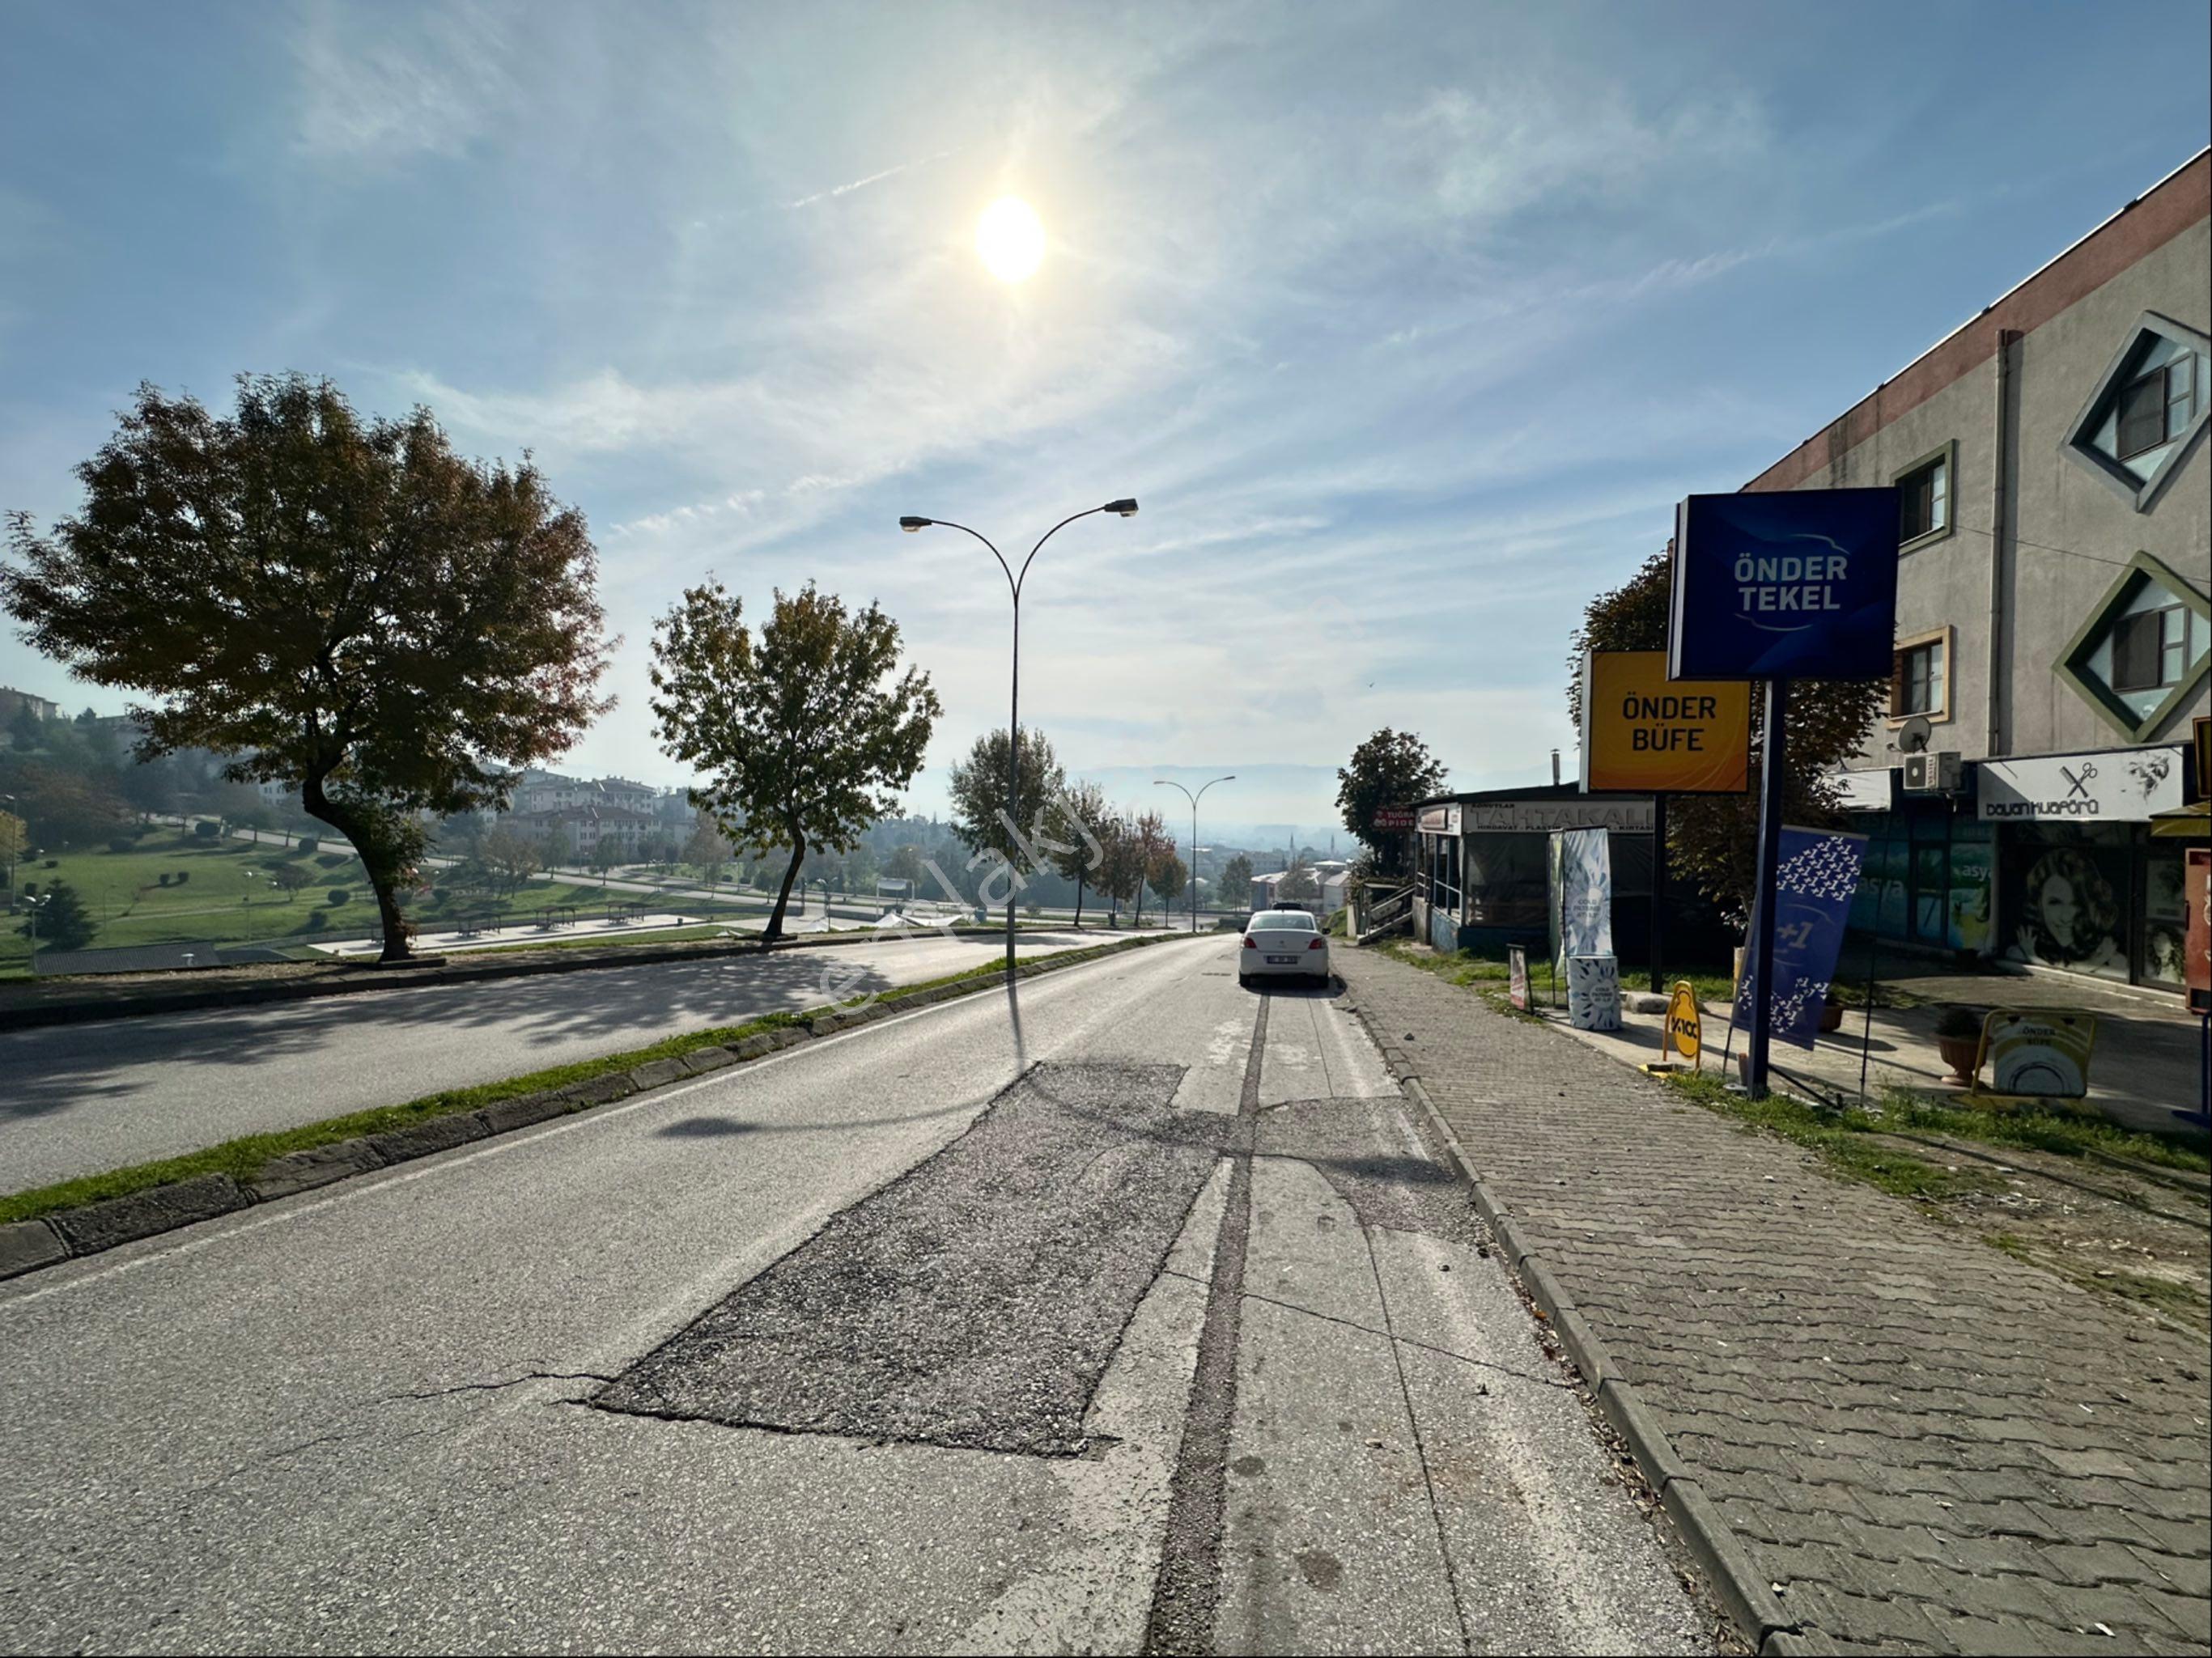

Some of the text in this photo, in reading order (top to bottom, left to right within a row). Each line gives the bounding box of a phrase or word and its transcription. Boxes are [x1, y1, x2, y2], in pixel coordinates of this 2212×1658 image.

[1734, 553, 1848, 582] ÖNDER
[1738, 586, 1841, 611] TEKEL
[1623, 691, 1716, 719] ÖNDER
[1632, 723, 1704, 751] BÜFE
[1777, 922, 1813, 949] +1
